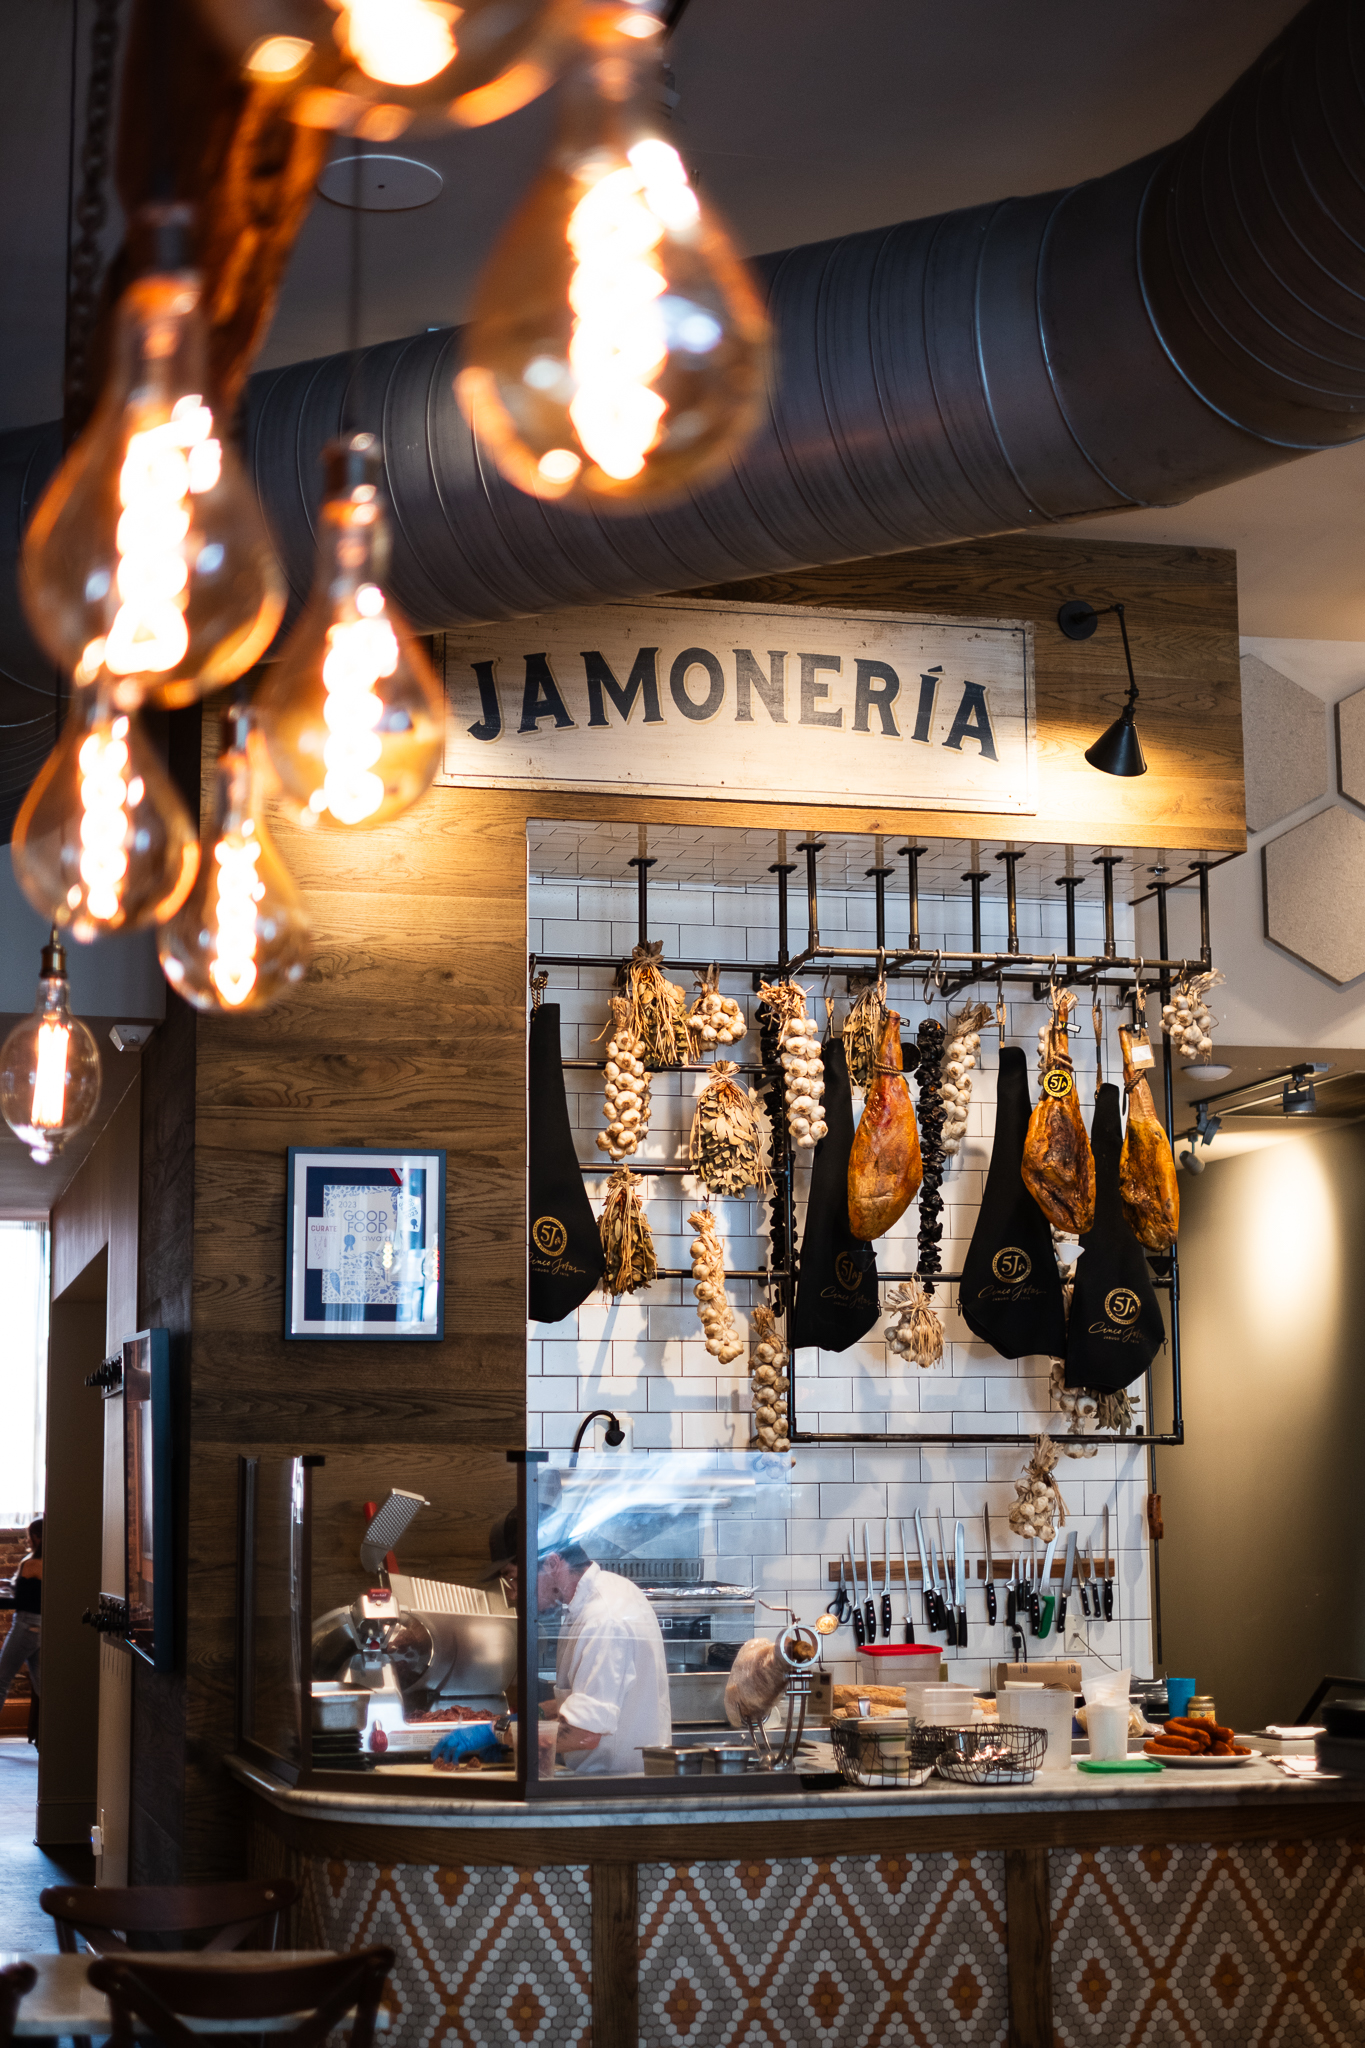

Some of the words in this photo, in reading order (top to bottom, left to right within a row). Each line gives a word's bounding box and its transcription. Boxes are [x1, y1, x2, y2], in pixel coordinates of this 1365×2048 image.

[467, 646, 1000, 762] JAMONERÍA
[1049, 1075, 1064, 1091] 5J
[338, 1200, 357, 1209] 2023
[343, 1209, 388, 1221] GOOD
[347, 1221, 388, 1233] FOOD
[540, 1224, 559, 1248] 5J
[1001, 1255, 1021, 1277] 5J
[1113, 1296, 1133, 1317] 5J
[1088, 1321, 1122, 1335] Cinco
